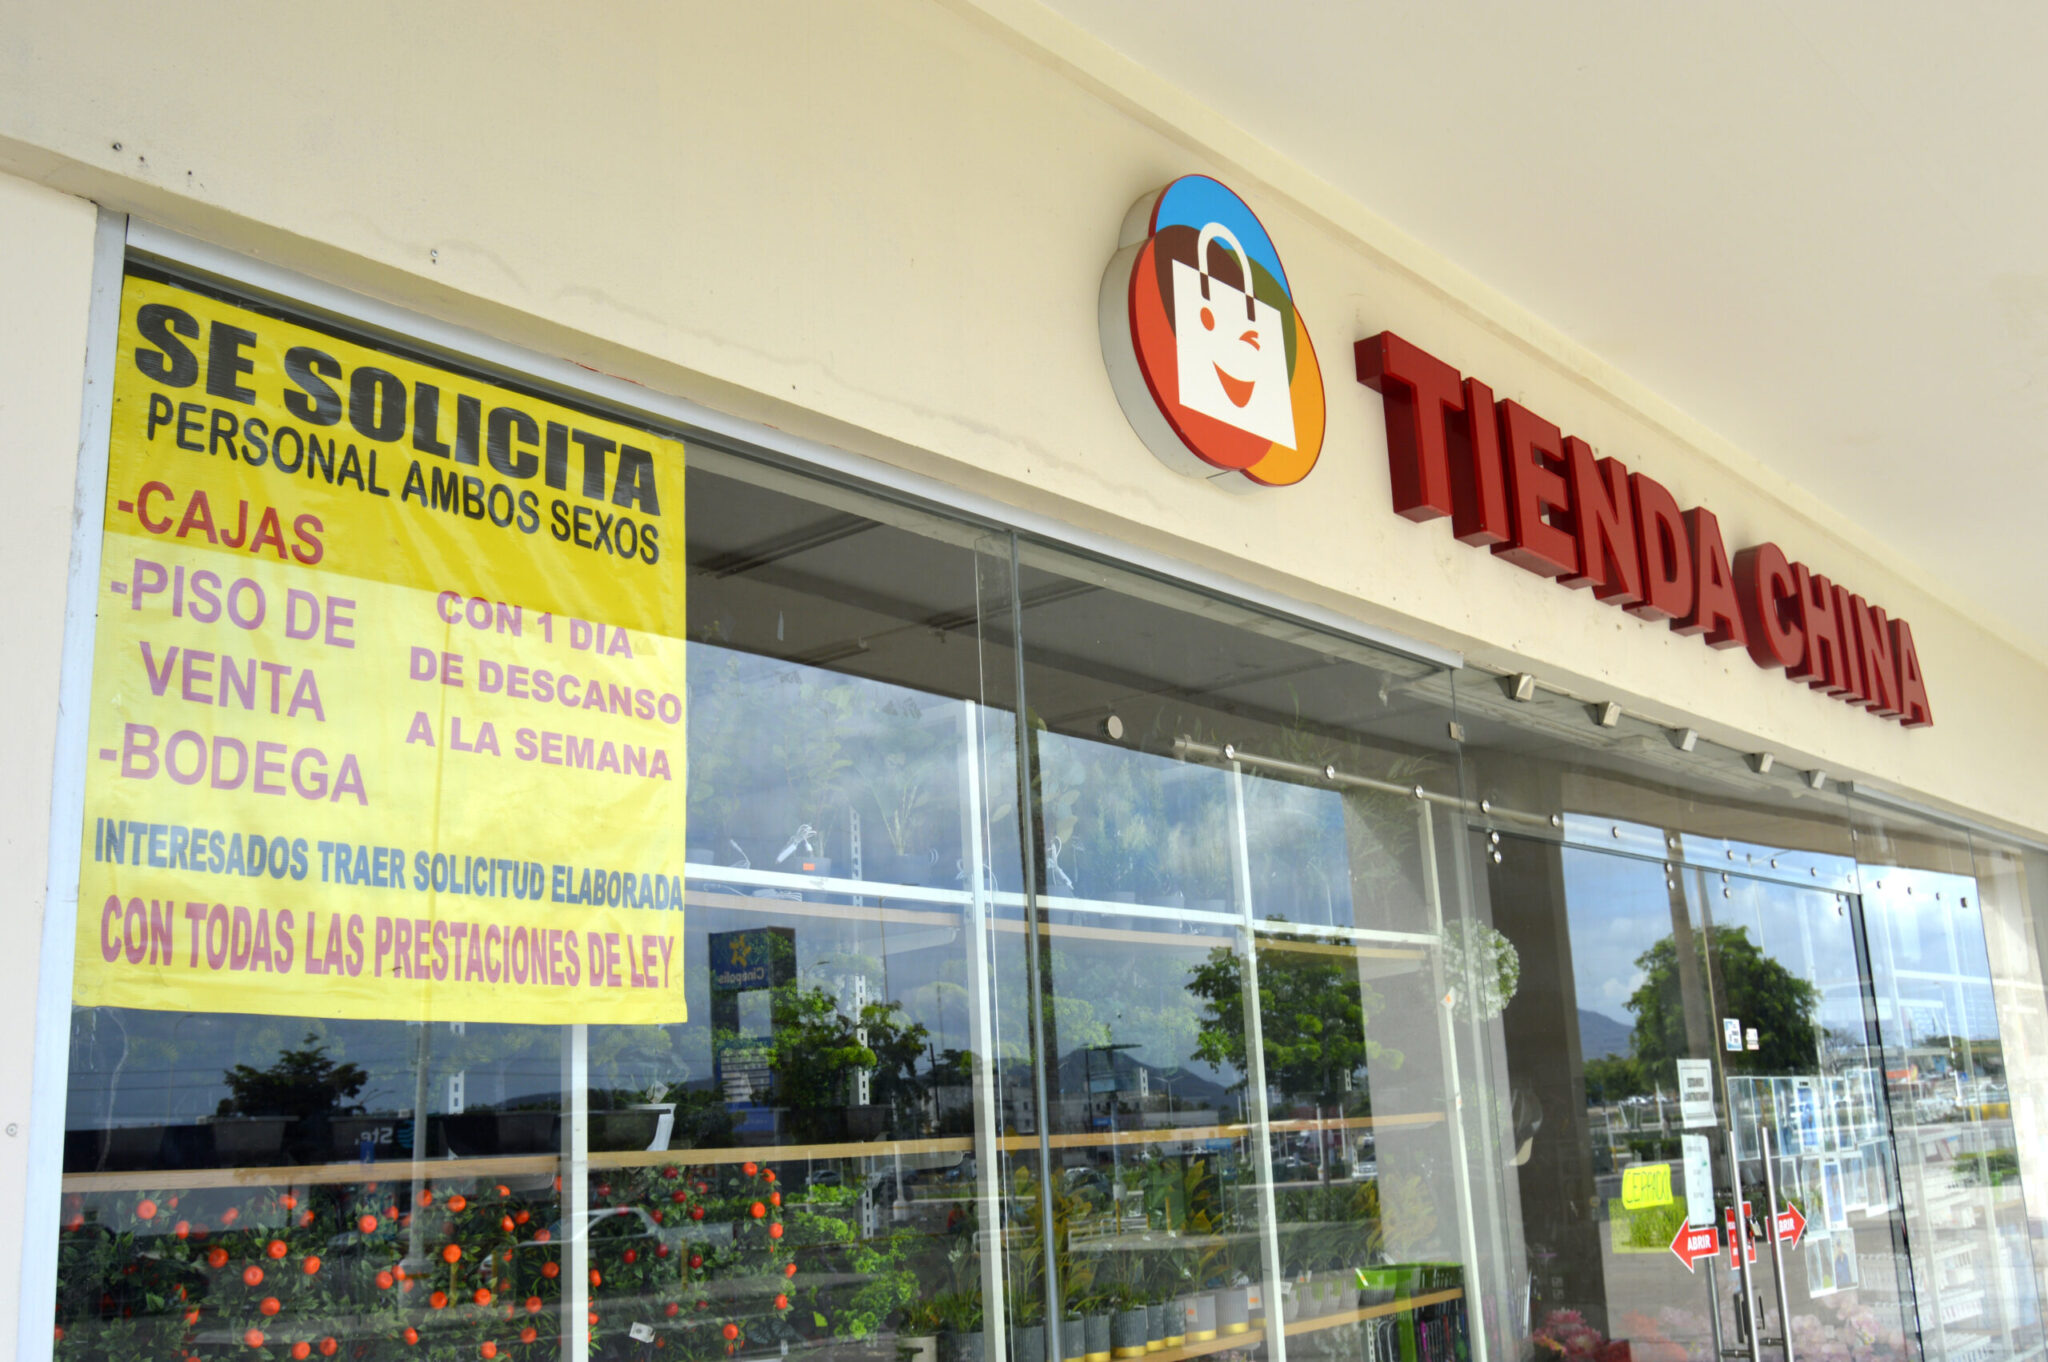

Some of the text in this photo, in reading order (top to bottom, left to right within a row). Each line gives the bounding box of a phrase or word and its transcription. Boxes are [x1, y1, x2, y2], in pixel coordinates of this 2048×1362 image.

[134, 303, 661, 516] SE SOLICITA
[147, 393, 660, 565] PERSONAL AMBOS SEXOS
[118, 480, 325, 565] -CAJAS
[1353, 331, 1933, 729] TIENDA CHINA
[110, 559, 356, 648] -PISO DE
[436, 590, 633, 658] CON 1 DIA
[139, 641, 326, 722] VENTA
[409, 646, 682, 725] DE DESCANSO
[99, 723, 368, 806] -BODEGA
[406, 712, 672, 780] A LA SEMANA
[95, 817, 684, 911] INTERESADOS TRAER SOLICITUD ELABORADA
[100, 895, 675, 988] CON TODAS LAS PRESTACIONES DE LEY
[1687, 1234, 1712, 1251] ABRIR
